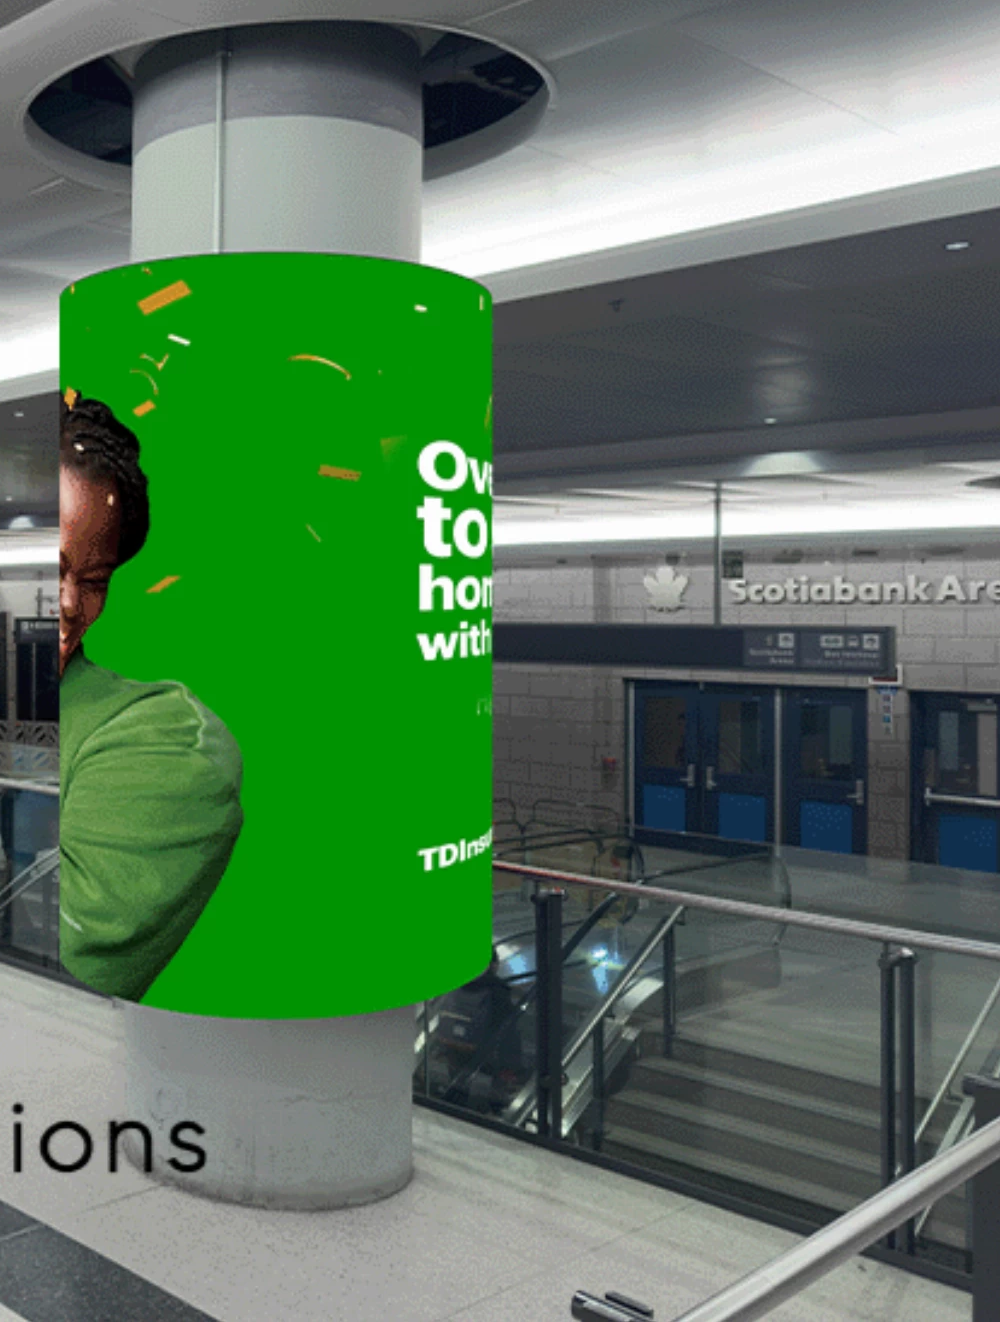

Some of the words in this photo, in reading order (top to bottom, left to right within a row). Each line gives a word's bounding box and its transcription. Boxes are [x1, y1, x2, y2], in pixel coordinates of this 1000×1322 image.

[418, 441, 492, 495] Ov
[417, 496, 488, 558] to
[728, 576, 932, 604] Scotiabank
[417, 619, 491, 660] with
